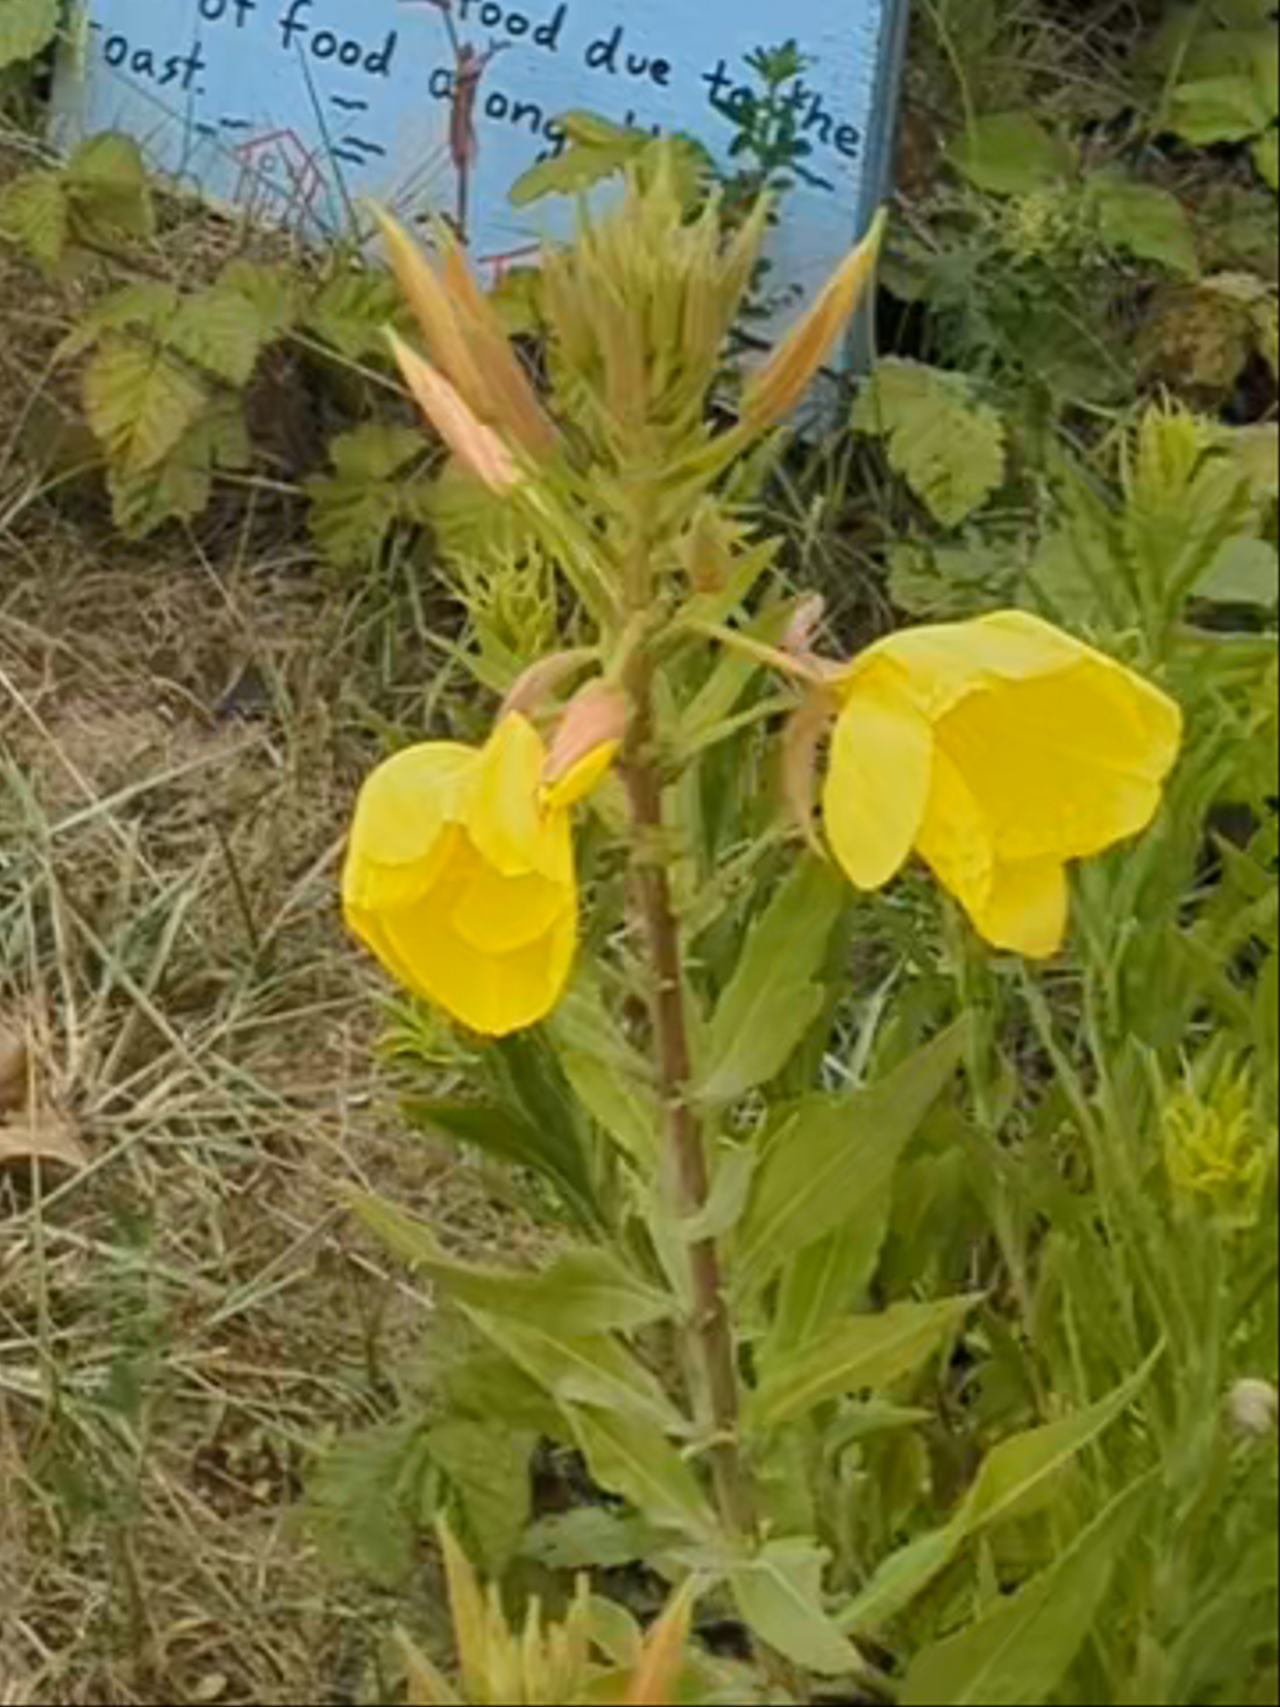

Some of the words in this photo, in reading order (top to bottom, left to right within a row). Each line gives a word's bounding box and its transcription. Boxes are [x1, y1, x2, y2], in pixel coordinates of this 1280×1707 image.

[88, 20, 207, 96] oast.
[583, 25, 672, 87] due
[777, 78, 861, 159] the
[427, 66, 571, 165] aong
